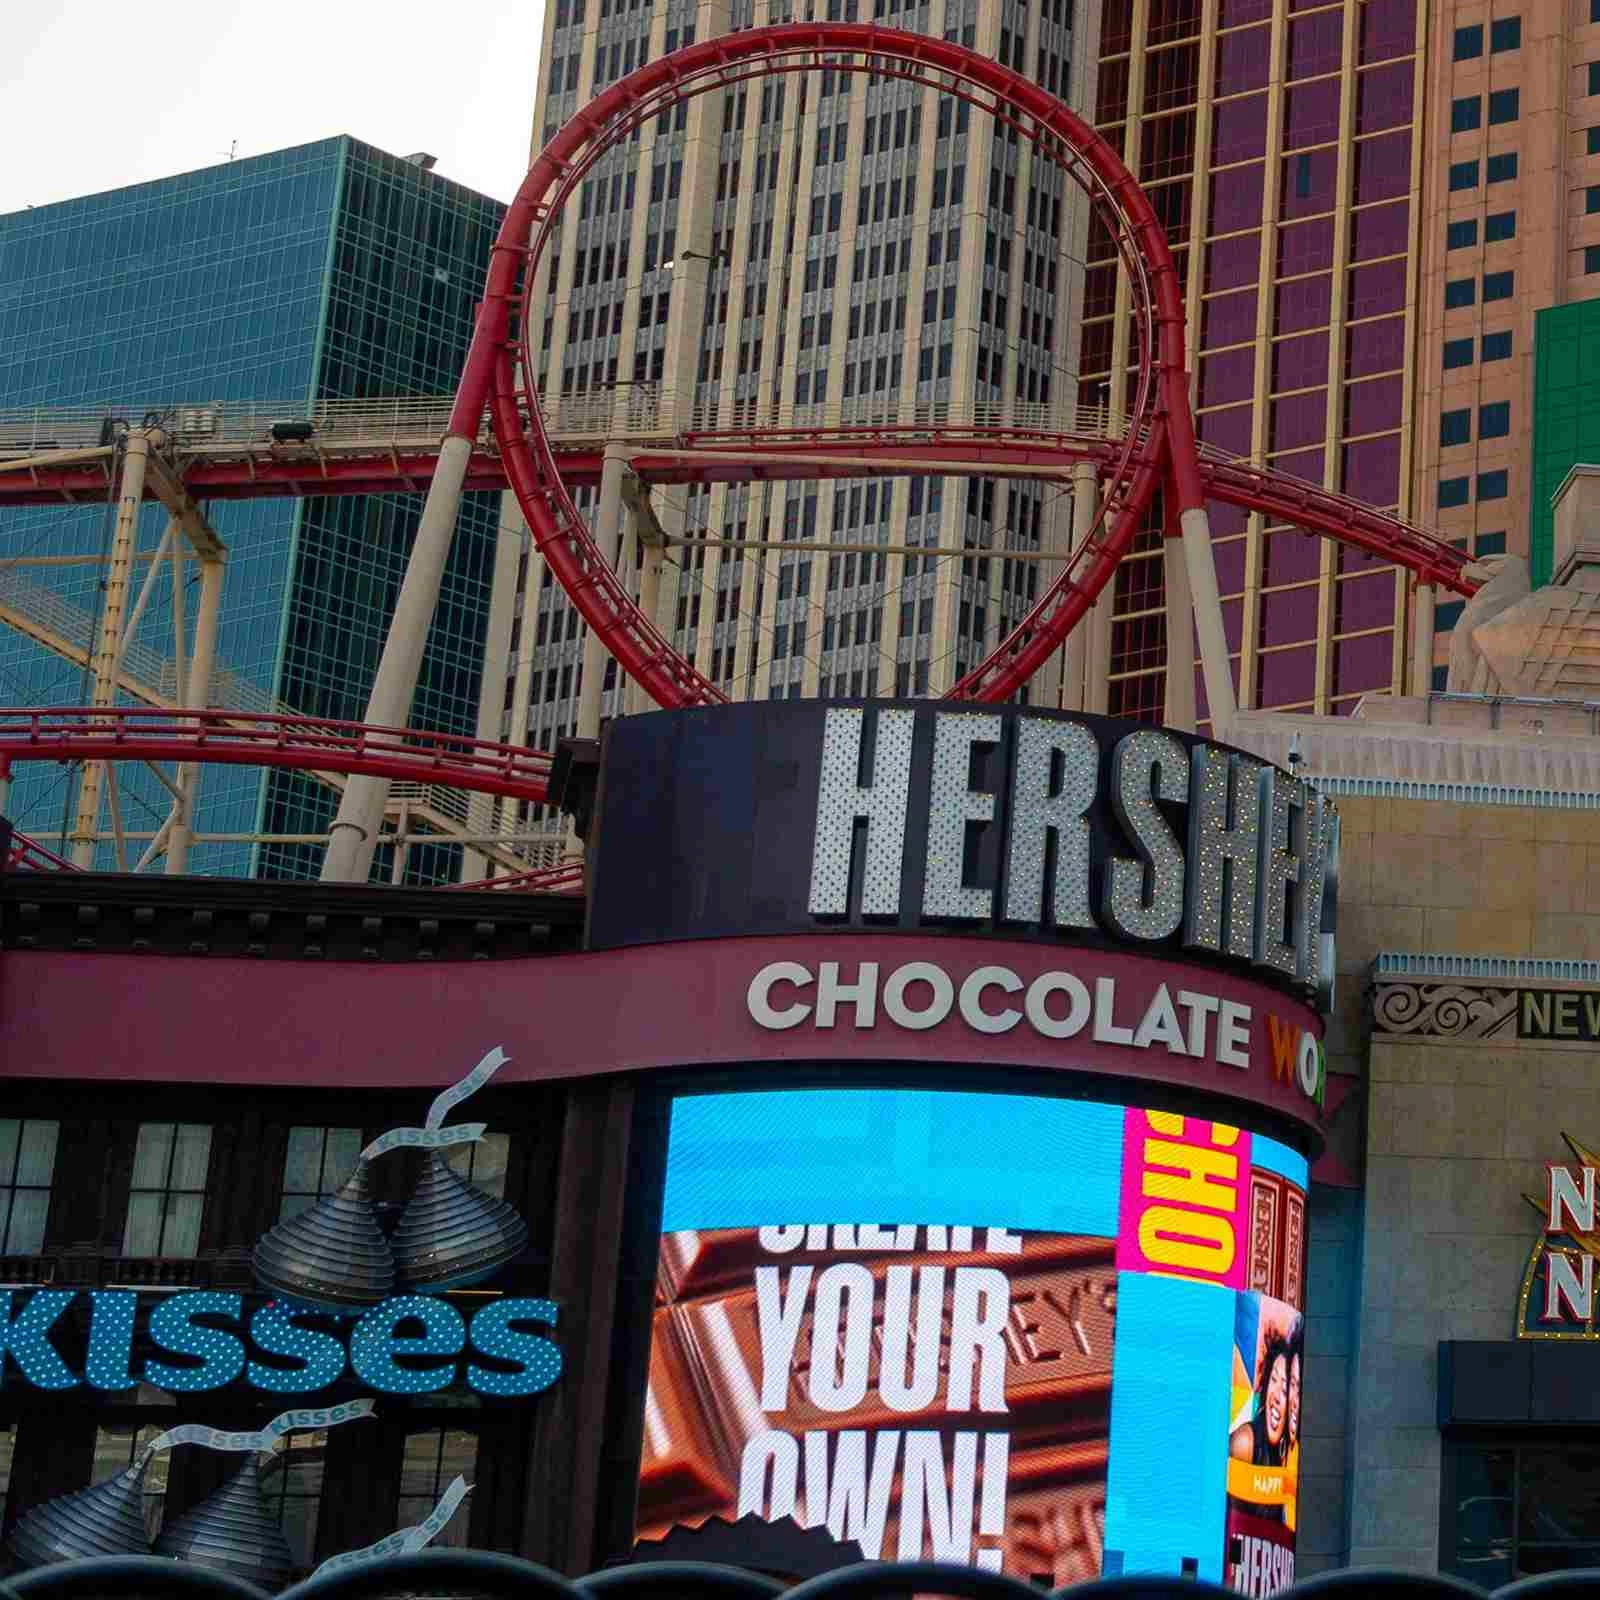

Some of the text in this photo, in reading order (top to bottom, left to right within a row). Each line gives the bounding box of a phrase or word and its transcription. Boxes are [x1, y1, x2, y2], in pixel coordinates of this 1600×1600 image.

[746, 961, 1252, 1069] CHOCOLATE
[755, 1262, 1011, 1413] YOUR
[738, 1430, 1009, 1575] OWN!
